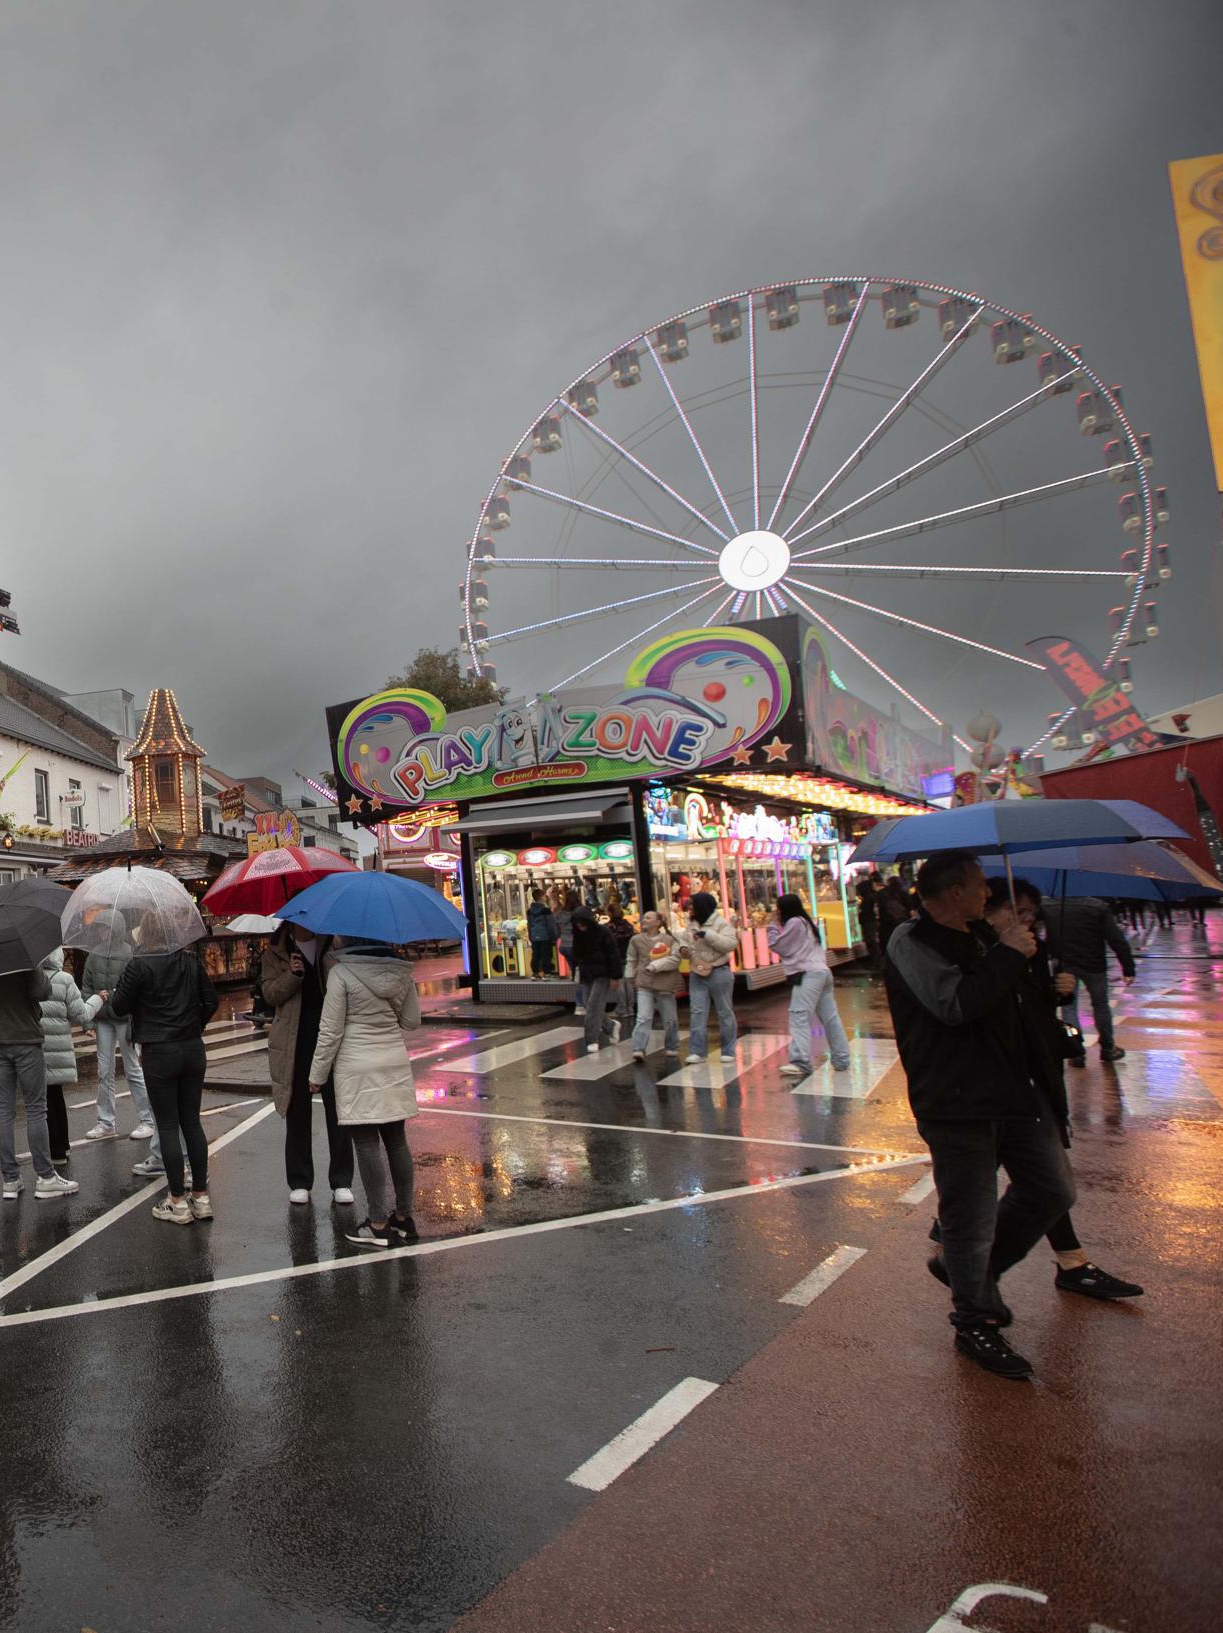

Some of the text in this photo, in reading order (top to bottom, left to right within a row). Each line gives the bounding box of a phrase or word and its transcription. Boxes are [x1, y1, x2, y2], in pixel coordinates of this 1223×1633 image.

[397, 710, 707, 799] PLAY ZONE
[66, 830, 100, 847] BEATRI
